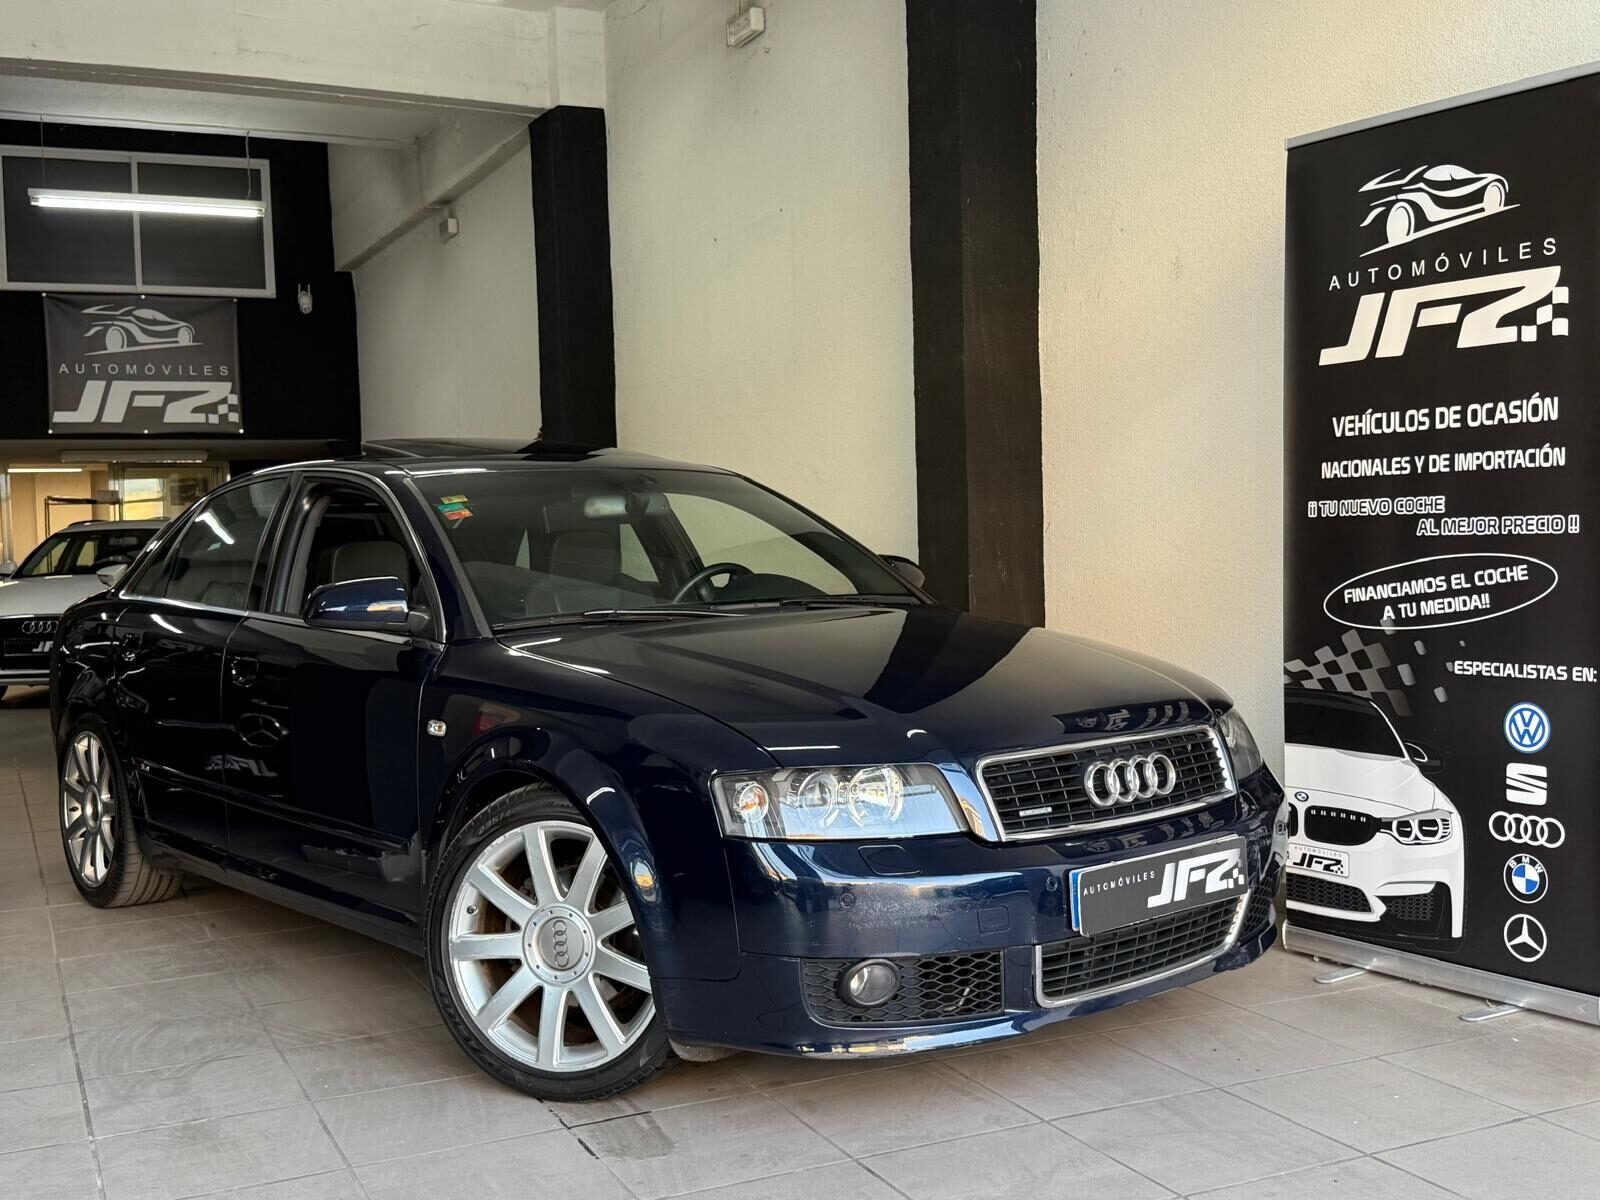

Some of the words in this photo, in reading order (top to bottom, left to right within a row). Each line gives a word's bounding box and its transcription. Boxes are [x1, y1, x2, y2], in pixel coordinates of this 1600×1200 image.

[1328, 237, 1557, 291] AUTOMÓVILES
[1318, 265, 1563, 366] JFZ
[58, 361, 230, 377] AUTOMÓVILES
[52, 379, 234, 424] JFZ
[1332, 408, 1430, 438] VEHÍCULOS
[1435, 405, 1462, 429] DE
[1466, 392, 1559, 428] OCASIÓN
[1321, 456, 1411, 479] NACIONALES
[1414, 455, 1425, 474] Y
[1428, 453, 1450, 473] DE
[1454, 442, 1566, 472] IMPORTACIÓN
[1319, 501, 1338, 517] TU
[1339, 498, 1391, 517] NUEVO
[1394, 496, 1446, 515] COCHE
[1416, 518, 1439, 536] AL
[1441, 517, 1500, 536] MEJOR
[1501, 515, 1565, 535] PRECIO
[1343, 575, 1447, 604] FINANCIAMOS
[1450, 573, 1471, 590] EL
[1474, 564, 1529, 587] COCHE
[1382, 605, 1396, 621] A
[1397, 602, 1417, 619] TU
[1420, 592, 1491, 616] MEDIDA!!
[1454, 660, 1568, 681] ESPECIALISTAS
[1572, 666, 1598, 683] EN:
[1083, 870, 1156, 896] AUTOMÓVILES
[1147, 848, 1241, 908] JFZ
[1508, 855, 1544, 873] BMW
